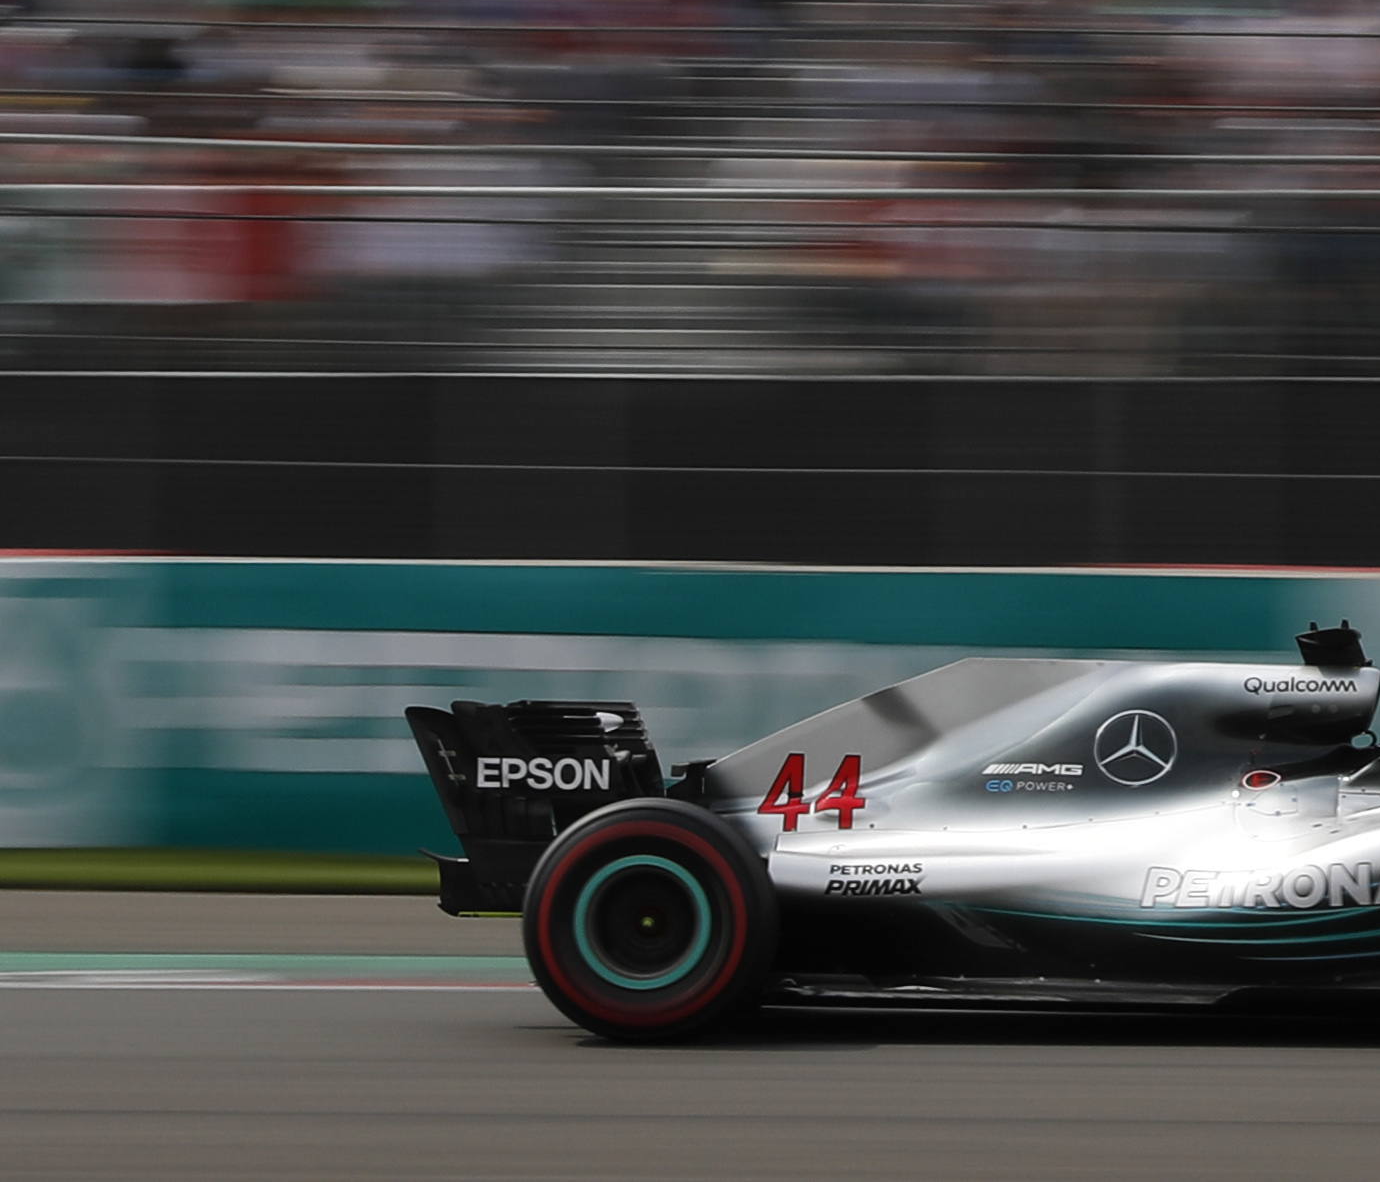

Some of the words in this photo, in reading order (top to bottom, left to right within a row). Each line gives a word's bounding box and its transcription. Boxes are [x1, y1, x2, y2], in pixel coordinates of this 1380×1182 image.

[1244, 677, 1357, 695] Qualcomm
[477, 757, 610, 790] EPSON
[757, 753, 866, 832] 44
[829, 863, 923, 875] PETRONAS
[825, 878, 926, 896] PRIMAX
